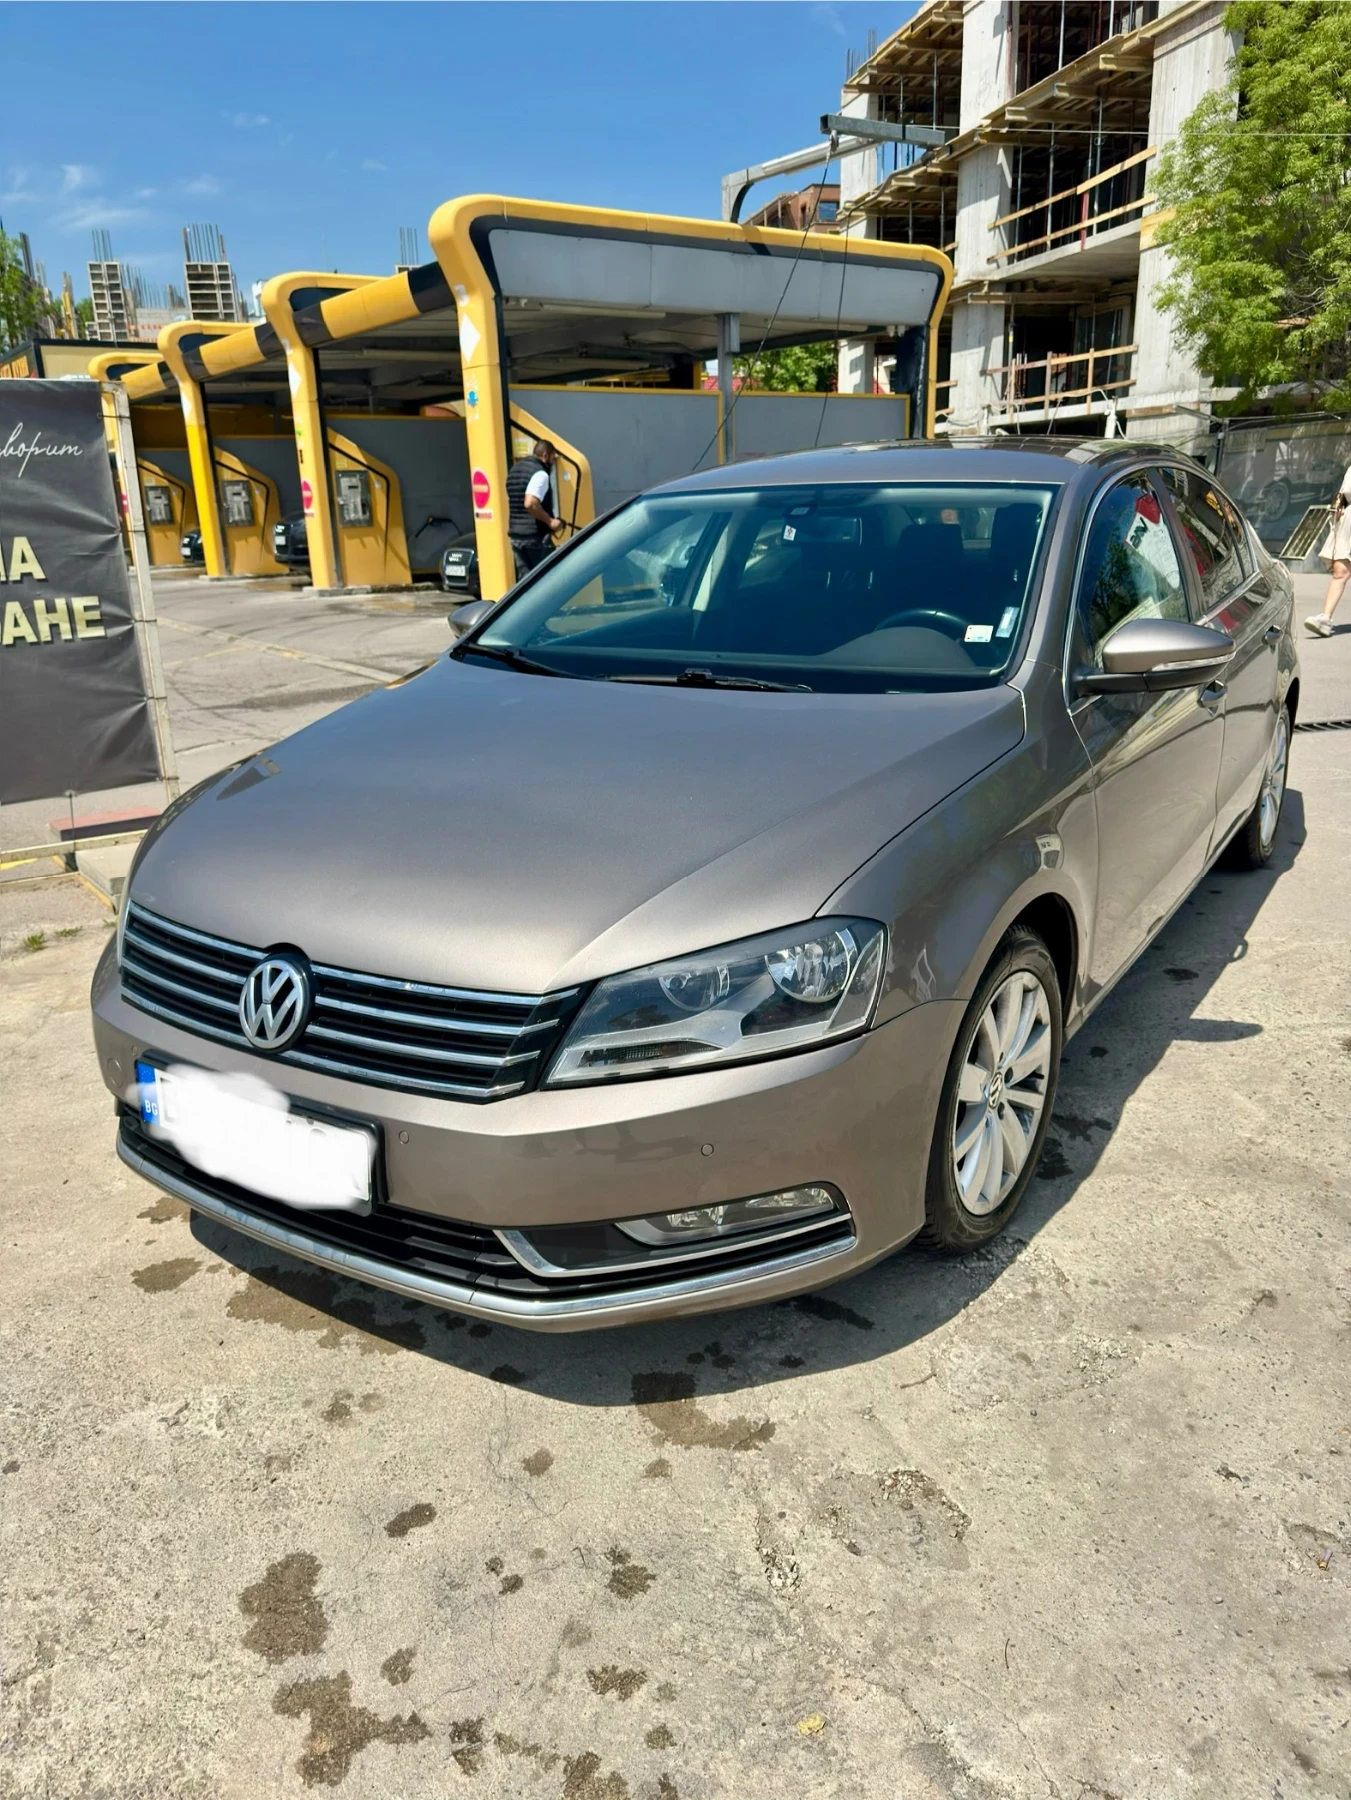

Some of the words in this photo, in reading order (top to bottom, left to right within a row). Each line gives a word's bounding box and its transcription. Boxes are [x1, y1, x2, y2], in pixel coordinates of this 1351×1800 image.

[0, 422, 83, 478] ворит
[0, 596, 106, 645] АНЕ
[240, 959, 304, 1050] VW
[144, 1099, 158, 1117] BG
